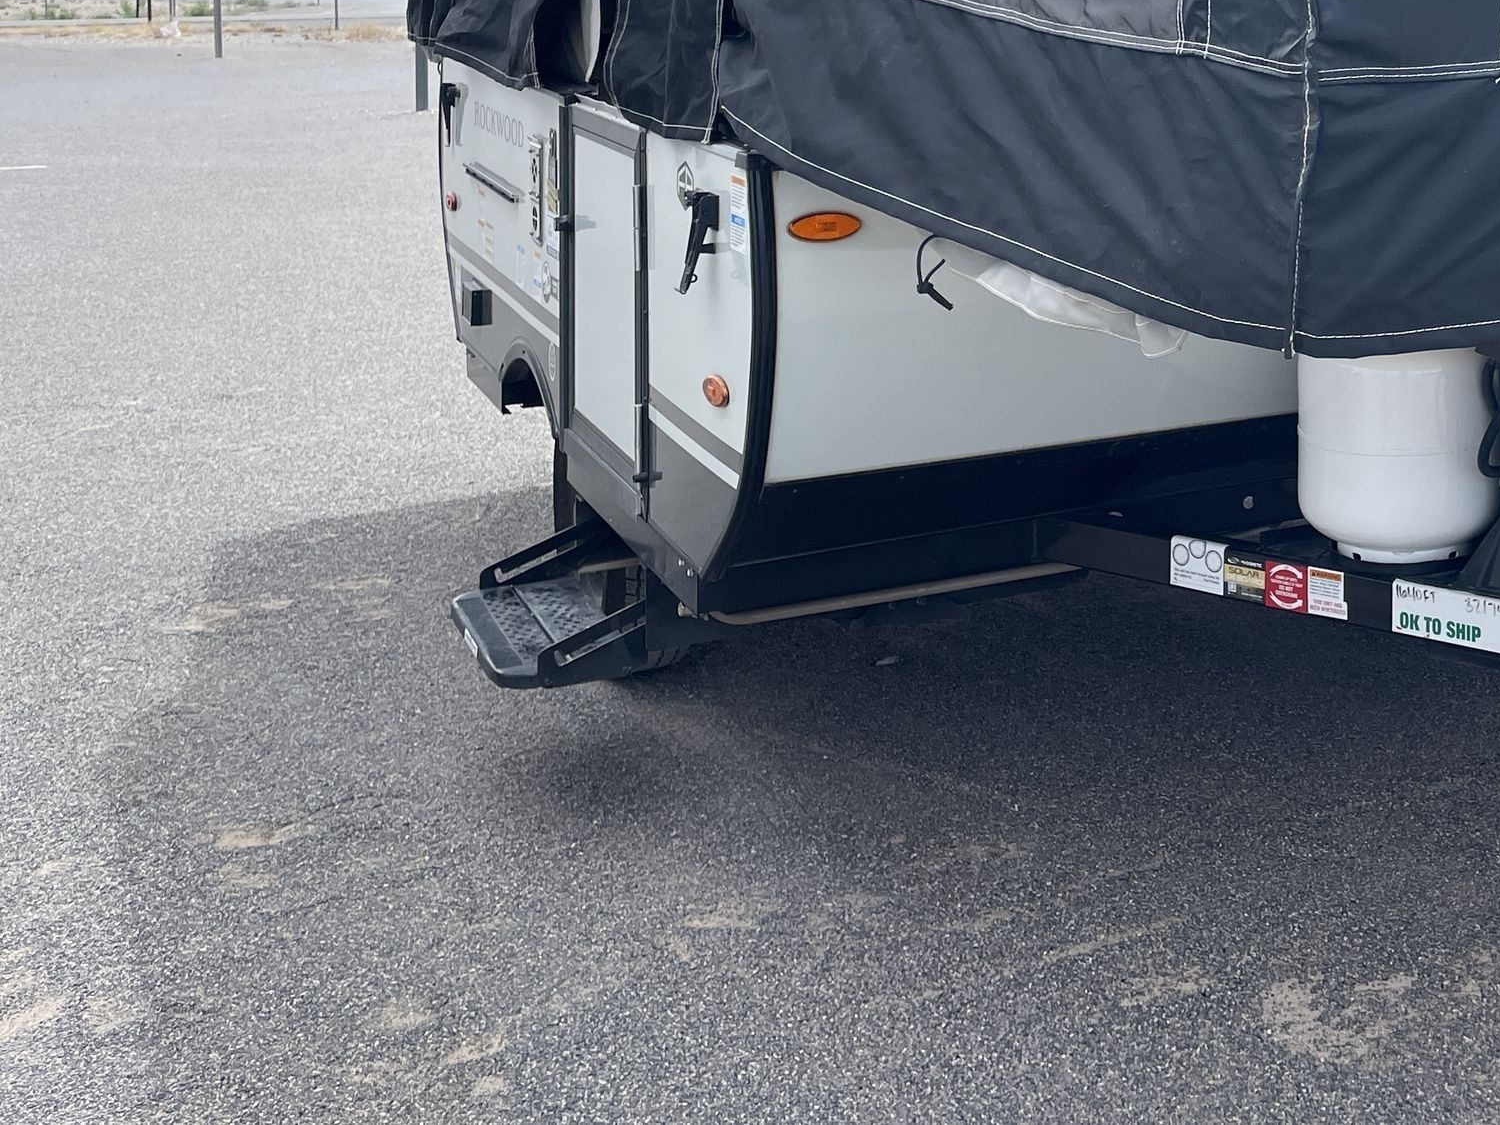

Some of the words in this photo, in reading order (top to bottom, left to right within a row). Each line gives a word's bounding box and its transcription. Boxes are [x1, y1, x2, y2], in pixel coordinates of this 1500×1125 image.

[474, 101, 525, 148] ROCKWOOD
[1228, 566, 1260, 578] SOLAR
[1399, 611, 1420, 631] OK
[1424, 616, 1442, 636] TO
[1446, 620, 1482, 642] SHIP
